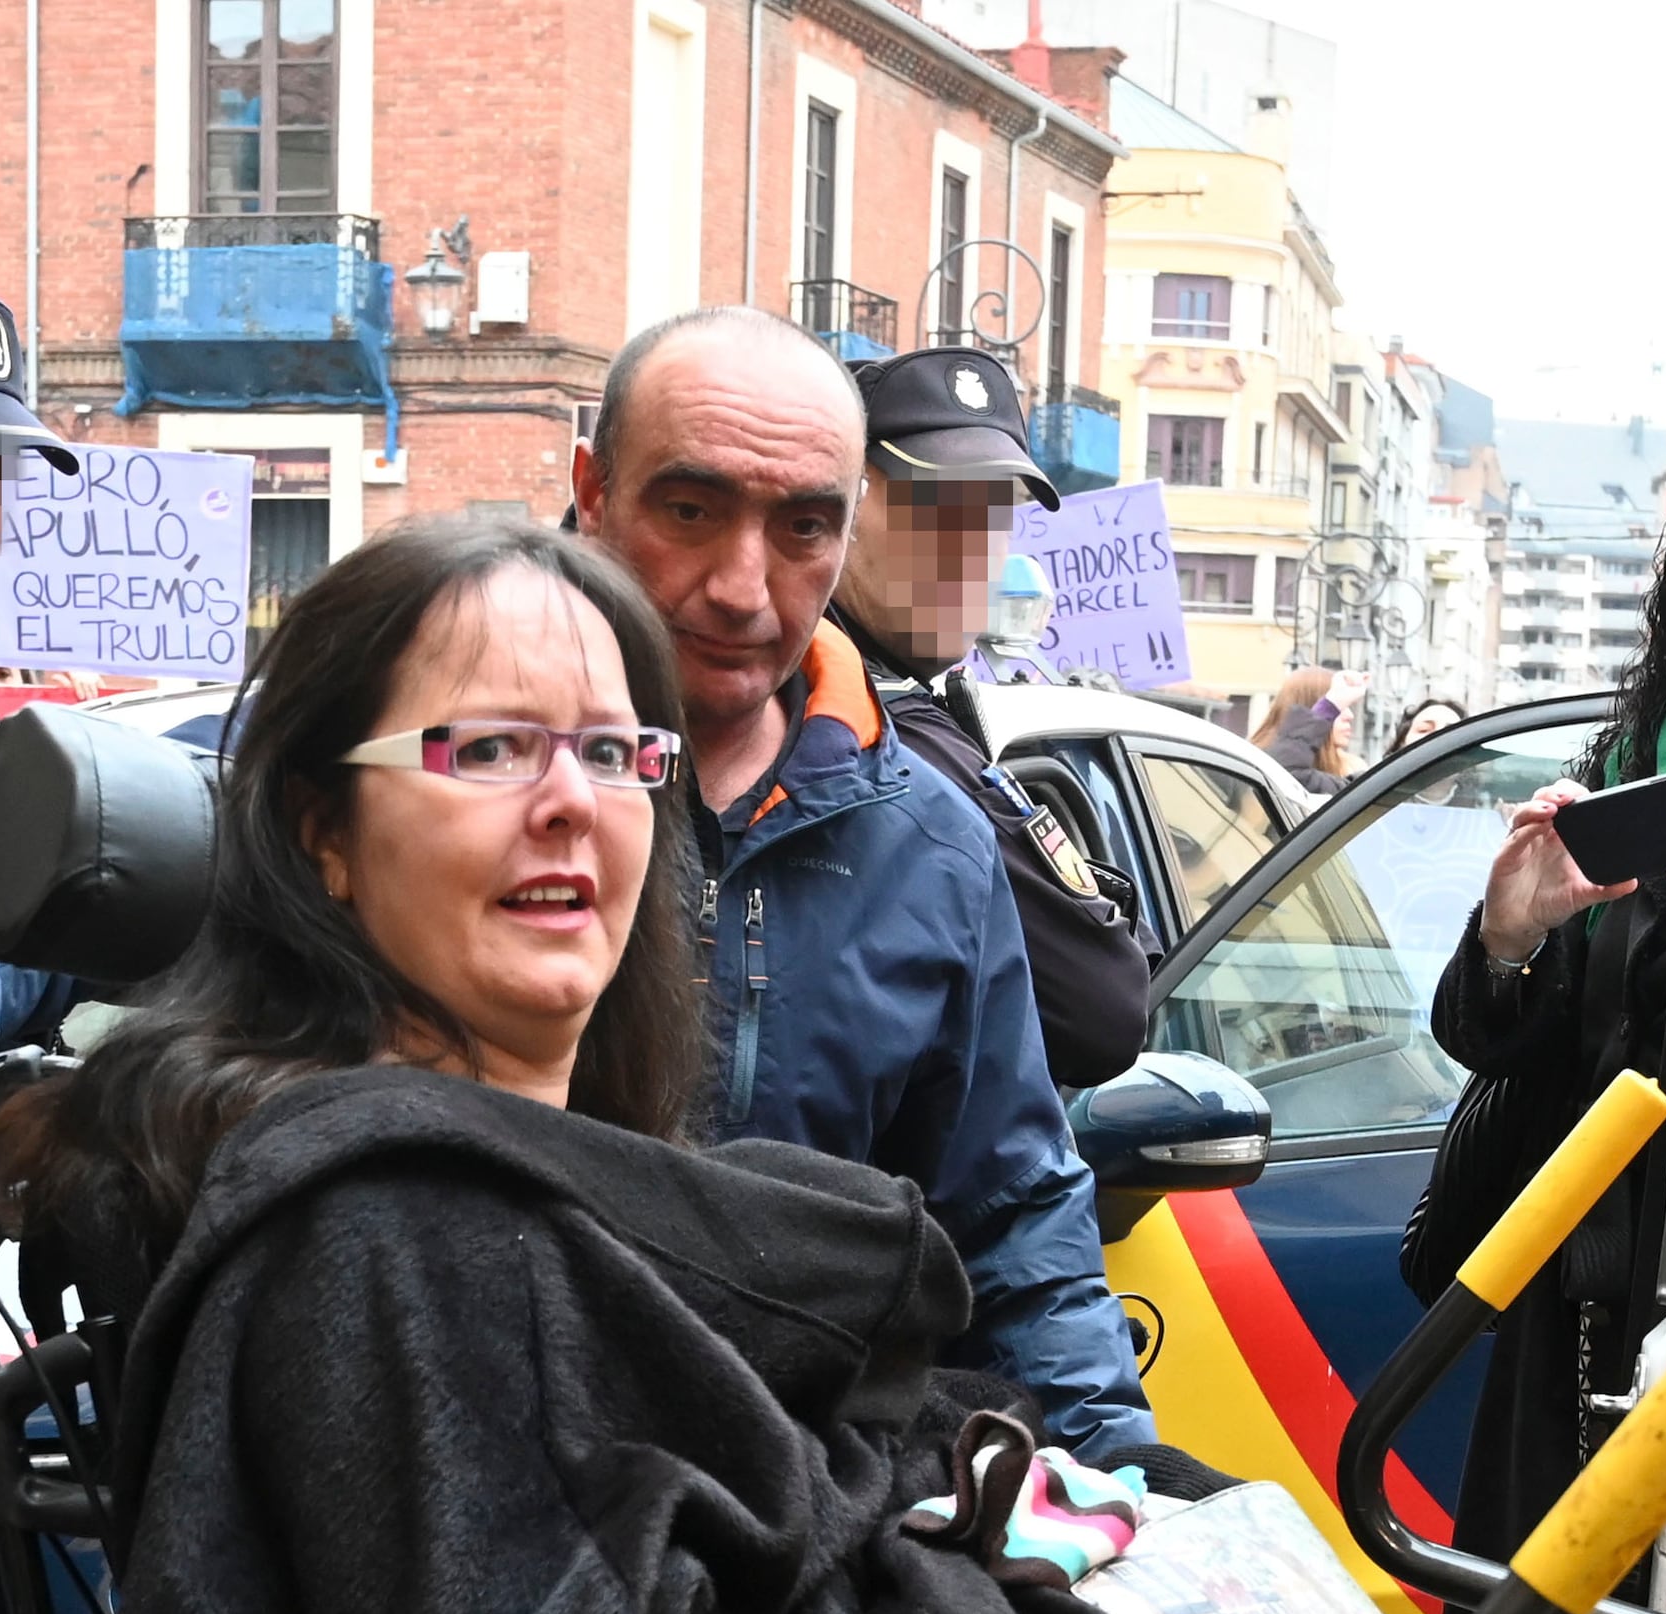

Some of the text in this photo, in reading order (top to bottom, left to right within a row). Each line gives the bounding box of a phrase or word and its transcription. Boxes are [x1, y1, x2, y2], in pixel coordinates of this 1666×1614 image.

[15, 450, 170, 512] EDRO,
[4, 507, 200, 572] APULLO,
[1034, 531, 1169, 589] TADORES
[13, 571, 240, 626] QUEREMOS
[17, 614, 73, 653] EL
[80, 620, 235, 665] TRULLO
